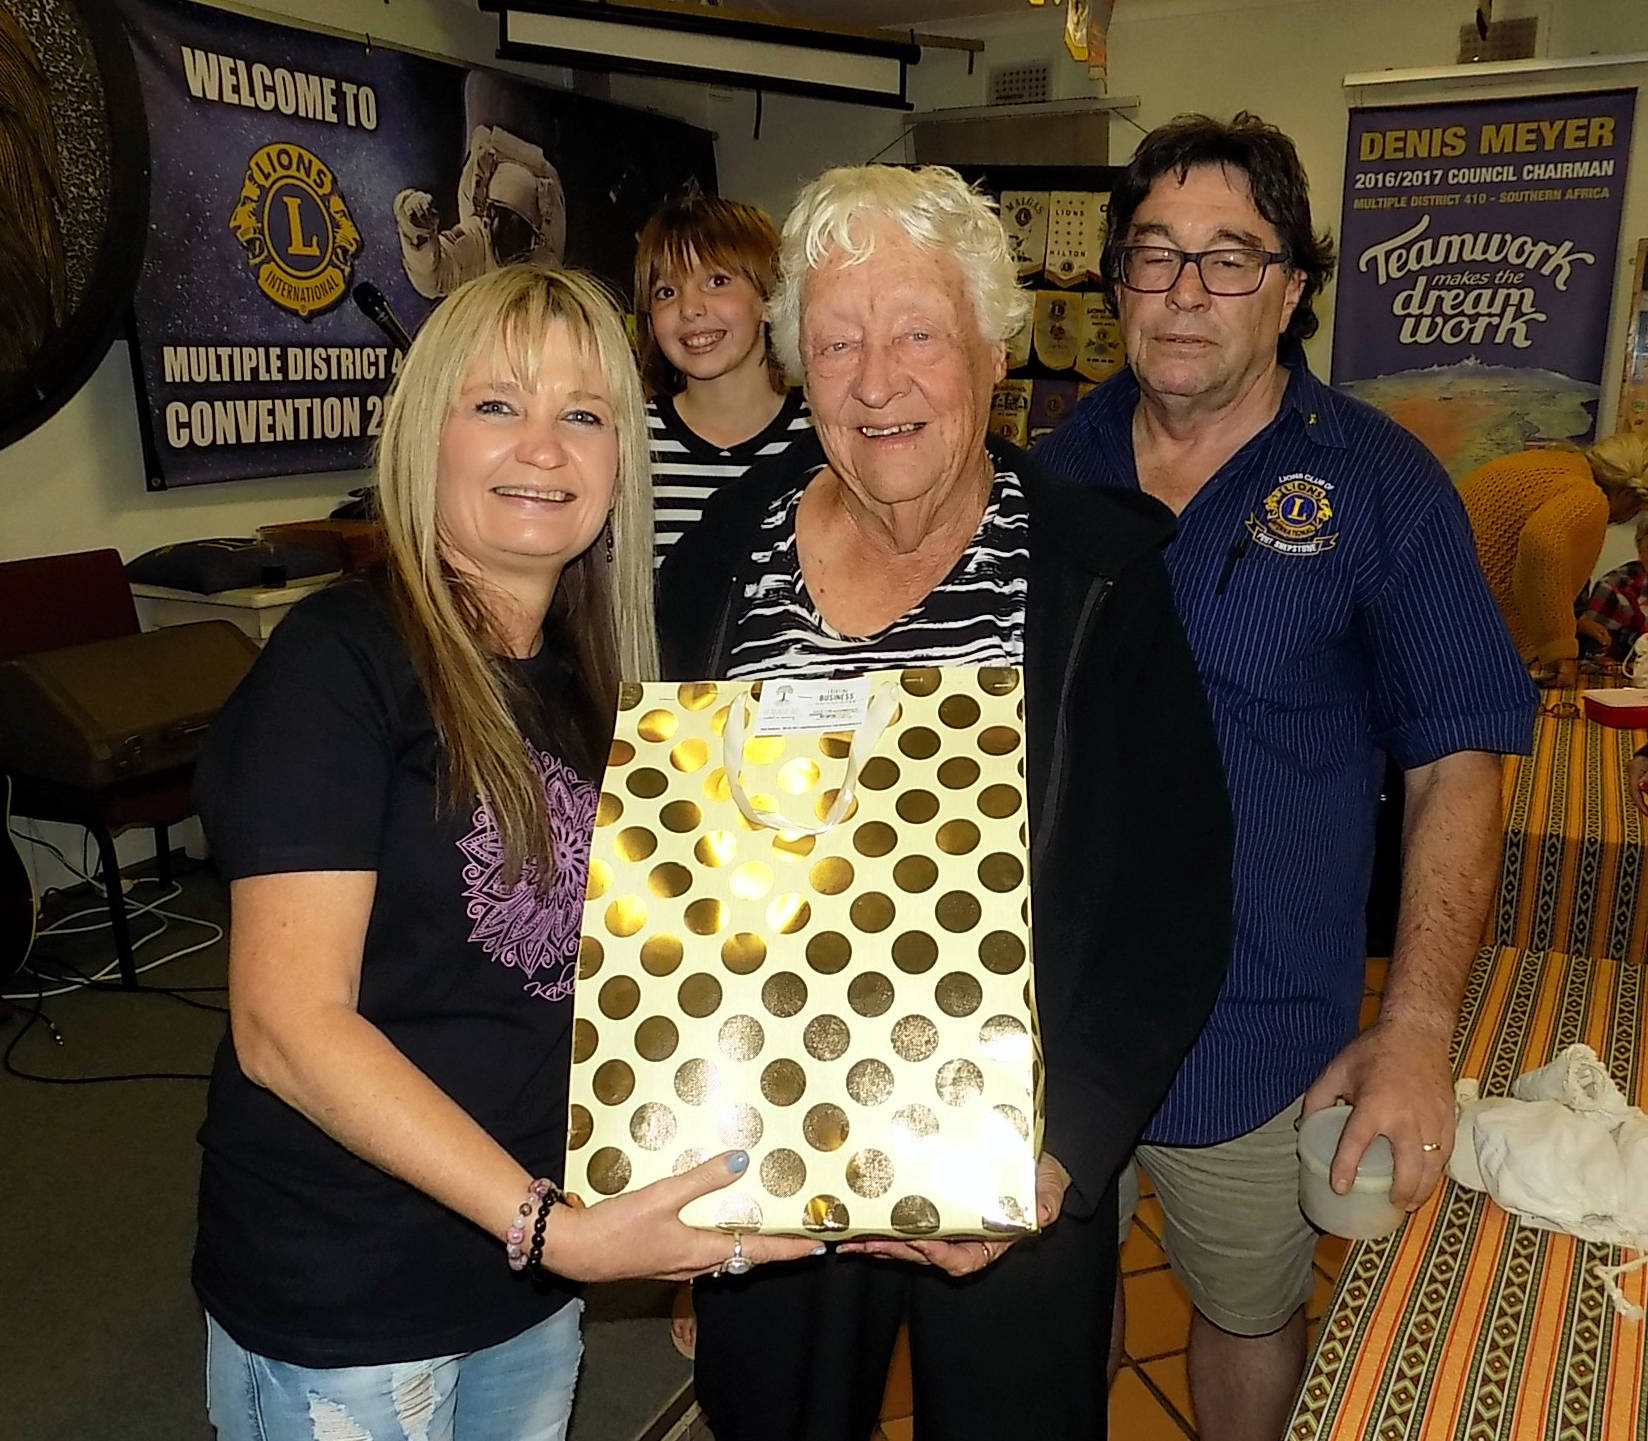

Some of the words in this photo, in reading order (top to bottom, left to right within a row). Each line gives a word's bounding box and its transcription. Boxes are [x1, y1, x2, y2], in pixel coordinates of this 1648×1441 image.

[181, 46, 338, 123] WELCOME
[341, 81, 377, 130] TO
[1360, 126, 1466, 161] DENIS
[1480, 116, 1616, 154] MEYER
[255, 148, 327, 190] LIONS
[1354, 169, 1443, 189] 2016/2017
[1447, 165, 1517, 184] COUNCIL
[1522, 160, 1615, 181] CHAIRMAN
[1055, 209, 1084, 217] LIONS
[1353, 195, 1407, 210] MULTIPLE
[1410, 193, 1460, 207] DISTRICT
[1464, 192, 1486, 205] 410
[1499, 190, 1562, 204] SOUTHERN
[1565, 187, 1610, 200] AFRICA
[282, 196, 321, 257] L
[1358, 214, 1596, 291] Teamwork
[264, 270, 340, 303] INTERNATIONAL
[1392, 276, 1537, 316] dream
[1431, 272, 1490, 286] makes
[1494, 269, 1526, 285] the
[1399, 305, 1548, 348] work
[162, 346, 284, 383] MULTIPLE
[287, 347, 388, 381] DISTRICT
[165, 396, 361, 449] CONVENTION
[1278, 473, 1304, 483] LIONS
[1283, 482, 1324, 498] LIONS
[1287, 497, 1307, 520] L
